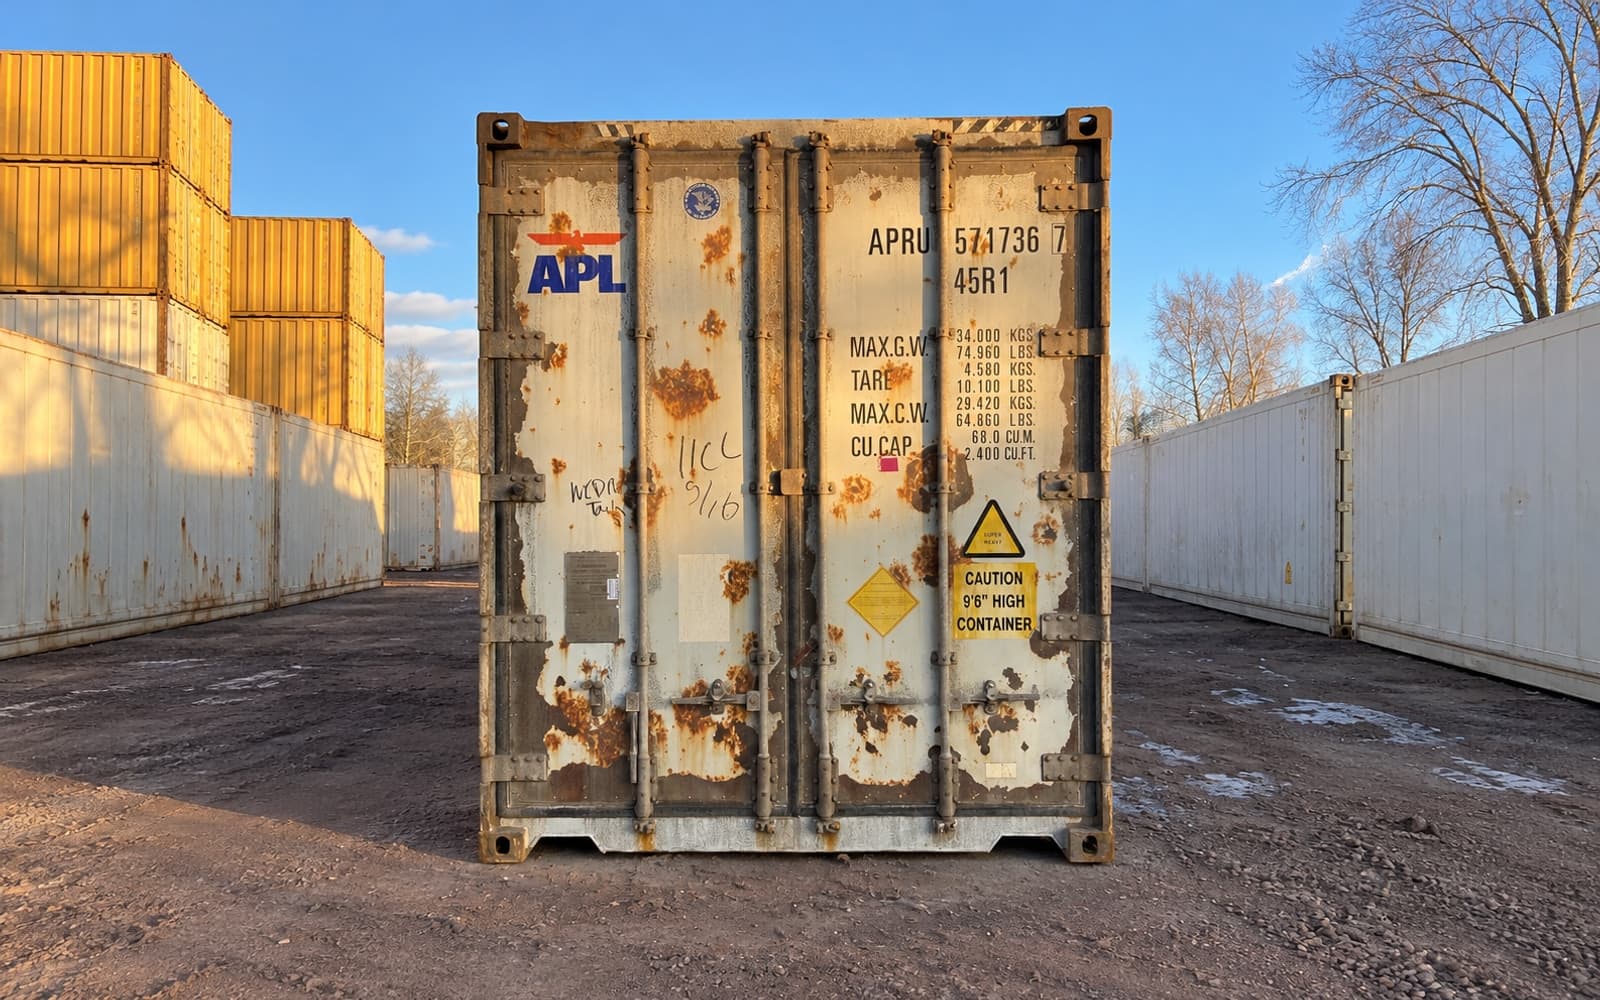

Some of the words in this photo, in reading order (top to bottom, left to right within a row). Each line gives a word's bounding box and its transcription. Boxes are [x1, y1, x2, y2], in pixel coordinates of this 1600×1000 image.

[868, 227, 930, 255] APRU
[955, 226, 1039, 255] 571736
[1053, 225, 1066, 253] 7
[527, 254, 626, 294] APL
[954, 266, 1008, 294] 45R1
[957, 328, 1000, 343] 34.000
[850, 335, 929, 358] MAX.G.W.
[957, 345, 1000, 359] 74.960
[1010, 345, 1036, 359] LBS.
[964, 362, 1000, 376] 4.580
[1010, 362, 1036, 376] KGS.
[851, 370, 893, 391] TARE
[957, 379, 1000, 393] 10.100
[1010, 379, 1037, 393] LBS.
[956, 396, 1000, 410] 29.420
[1010, 396, 1036, 410] KGS.
[851, 402, 929, 424] MAX.C.W.
[956, 413, 1000, 427] 64.860
[1010, 413, 1036, 427] LBS.
[972, 430, 1000, 444] 68.0
[1006, 429, 1036, 444] CU.M.
[964, 447, 1000, 461] 2.400
[1004, 446, 1036, 461] CU.FT.
[965, 571, 1023, 585] CAUTION
[963, 594, 988, 608] 9'6"
[992, 594, 1025, 608] HIGH
[957, 617, 1032, 631] CONTAINER
